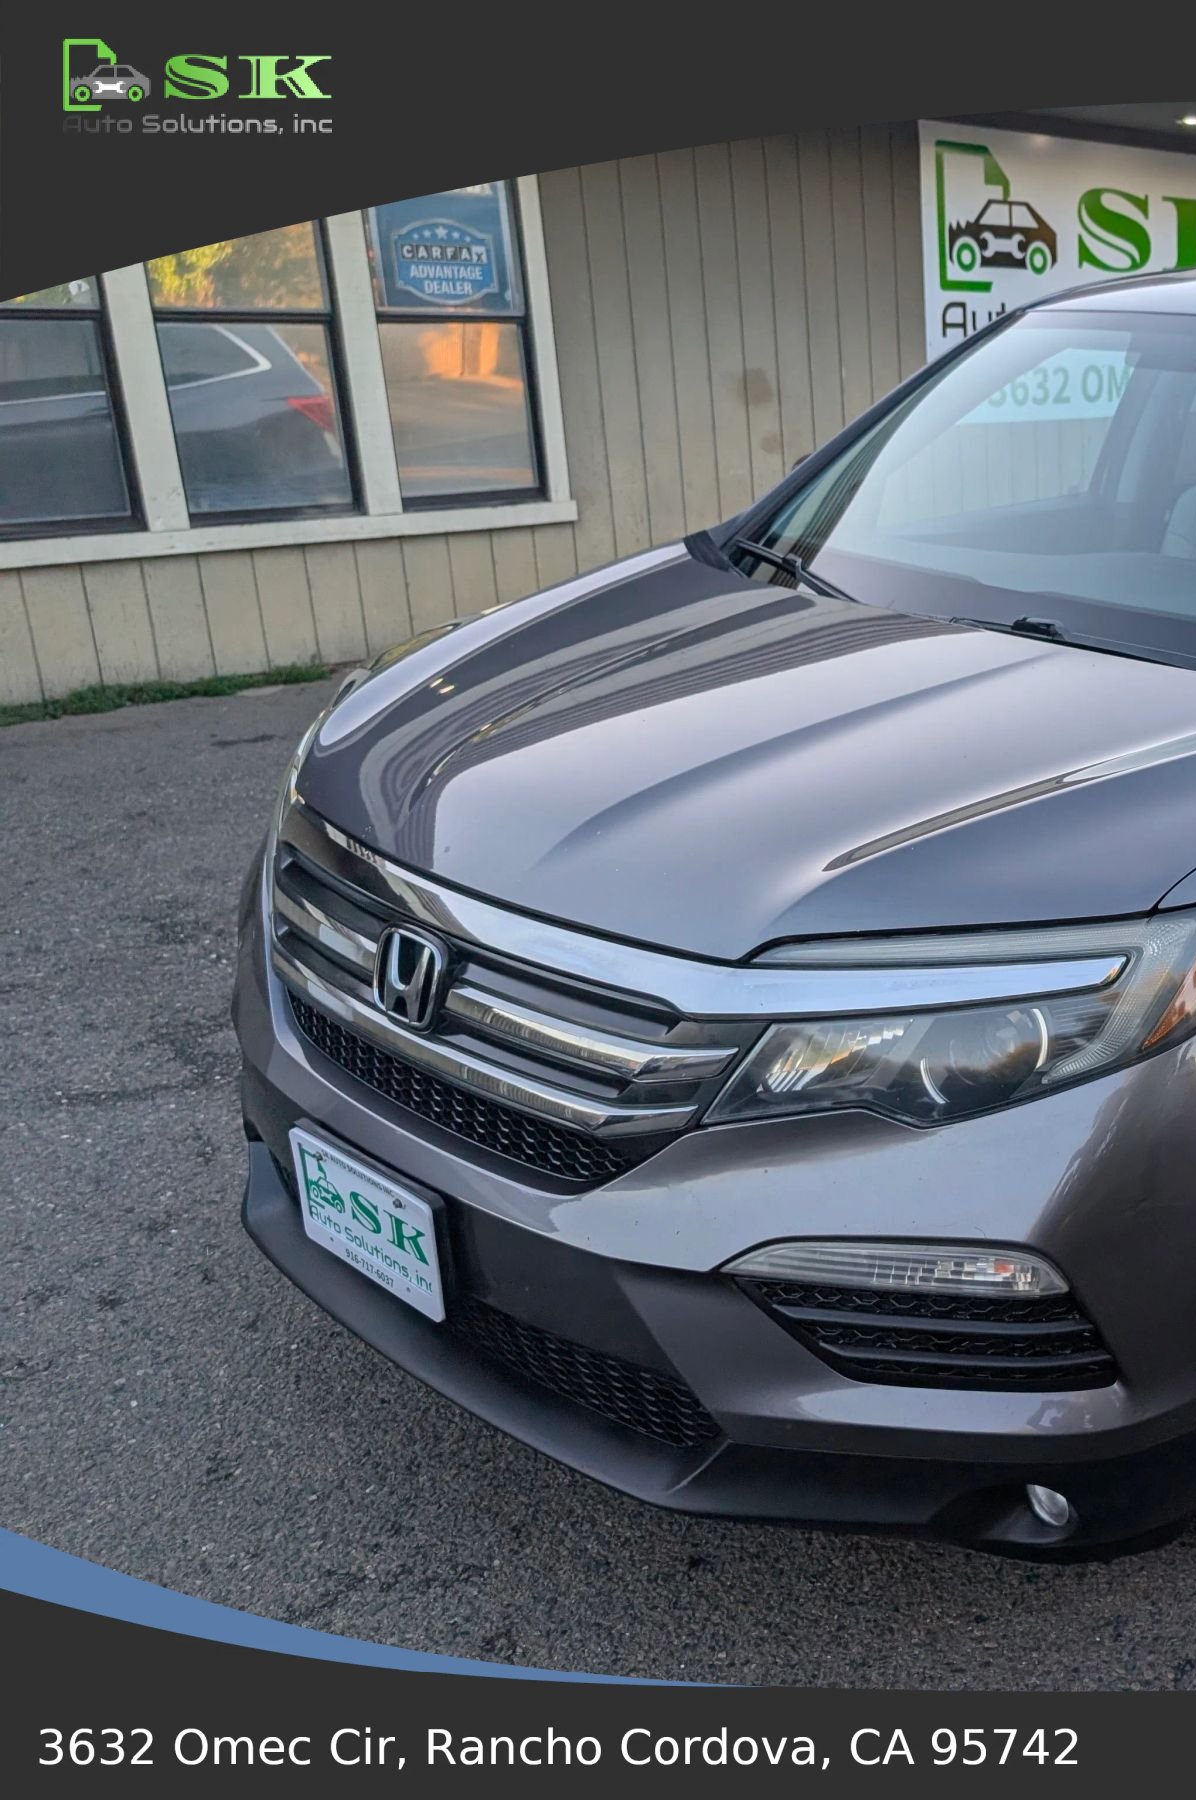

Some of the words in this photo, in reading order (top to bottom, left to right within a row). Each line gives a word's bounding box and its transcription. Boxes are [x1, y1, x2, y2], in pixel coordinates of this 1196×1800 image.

[402, 244, 487, 264] CARFAX
[410, 264, 483, 280] ADVANTAGE
[424, 281, 473, 295] DEALER
[350, 1191, 430, 1266] SK
[311, 1205, 341, 1234] Auto
[345, 1227, 412, 1283] Solutions,
[345, 1248, 394, 1288] 916-717-6037
